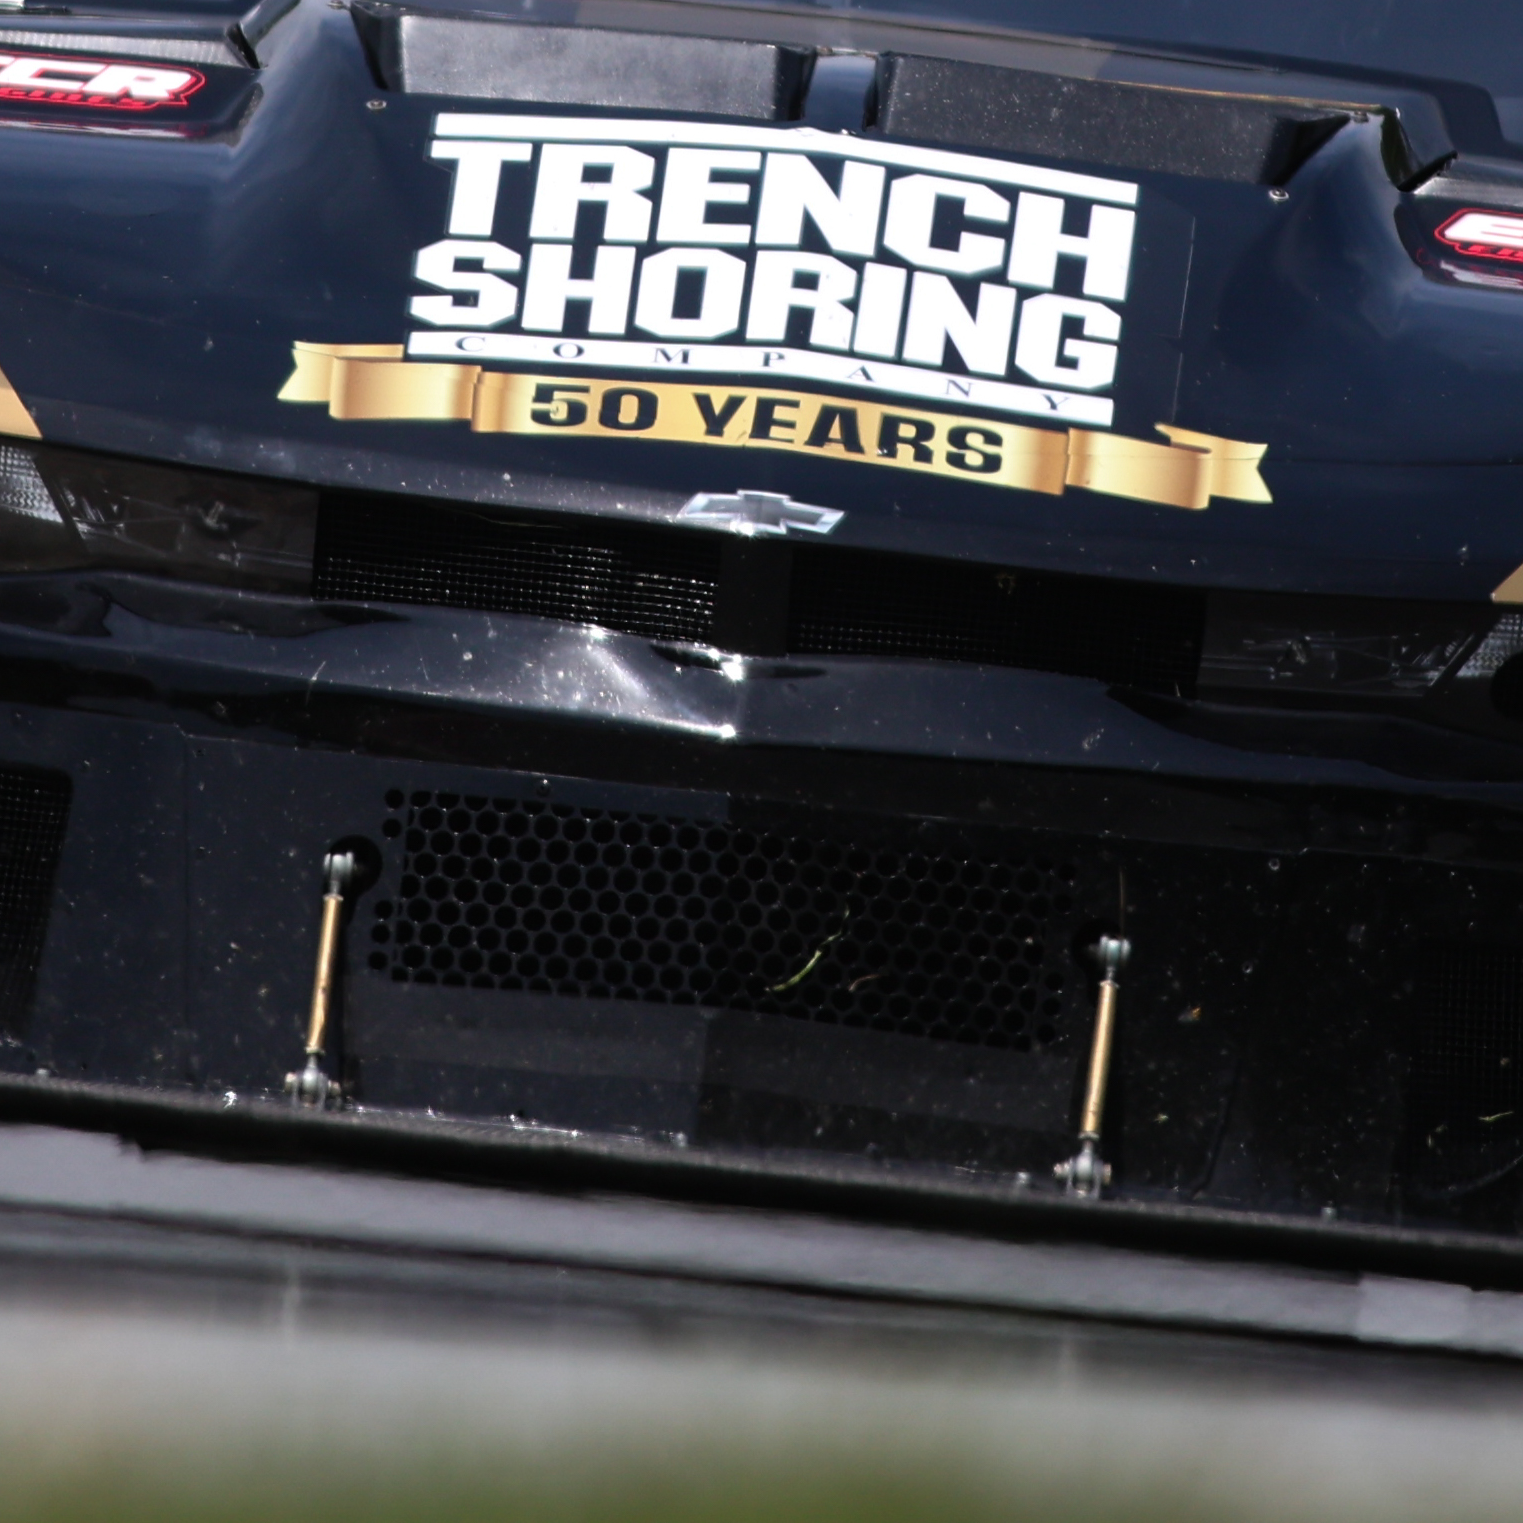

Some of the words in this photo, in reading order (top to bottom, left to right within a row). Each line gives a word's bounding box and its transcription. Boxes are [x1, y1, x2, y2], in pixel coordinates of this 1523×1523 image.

[430, 140, 1136, 301] TRENCH
[410, 239, 1123, 390] SHORING
[455, 335, 1072, 412] COMPANY
[529, 383, 659, 431] 50
[693, 392, 1004, 474] YEARS
